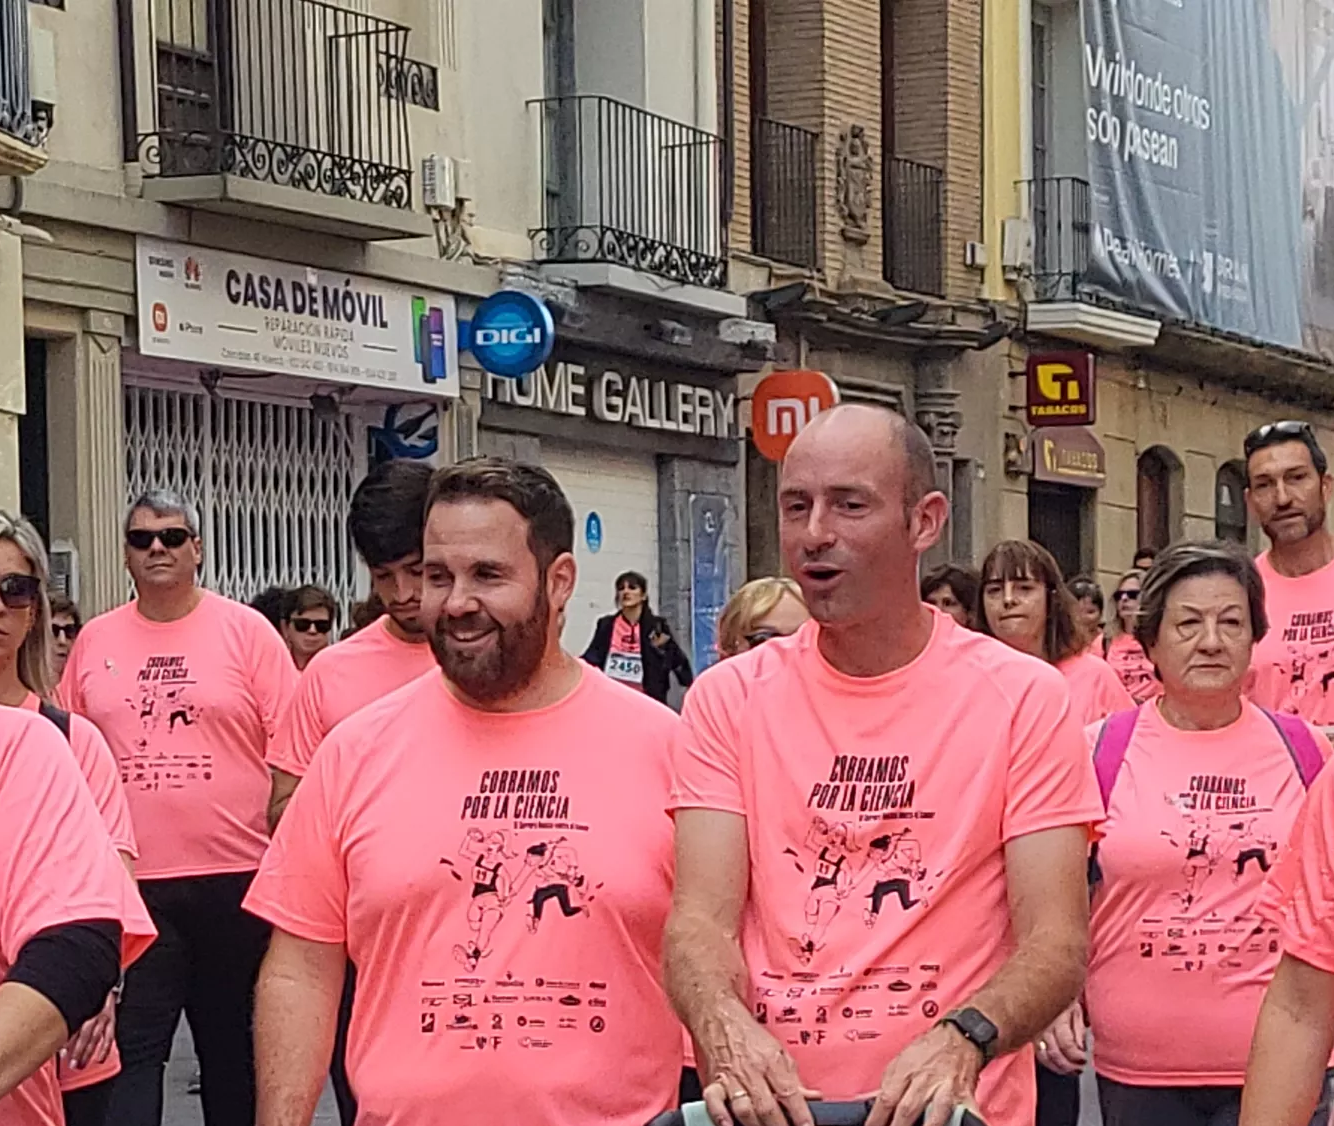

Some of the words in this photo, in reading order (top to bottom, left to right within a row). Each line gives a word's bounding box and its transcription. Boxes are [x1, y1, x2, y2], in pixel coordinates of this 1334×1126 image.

[225, 269, 289, 313] CASA
[291, 280, 319, 318] DE
[322, 277, 389, 329] MÓVIL
[475, 327, 542, 346] DIGI
[485, 361, 587, 417] HOME
[597, 370, 735, 440] GALLERY
[1031, 404, 1087, 416] TABACOS
[479, 769, 561, 794] CORRAMOS
[828, 754, 909, 783] CORRAMOS
[460, 795, 491, 821] POR
[493, 795, 510, 819] LA
[513, 794, 570, 820] CIENCIA
[806, 782, 841, 809] POR
[839, 783, 857, 812] LA
[859, 779, 916, 812] CIENCIA
